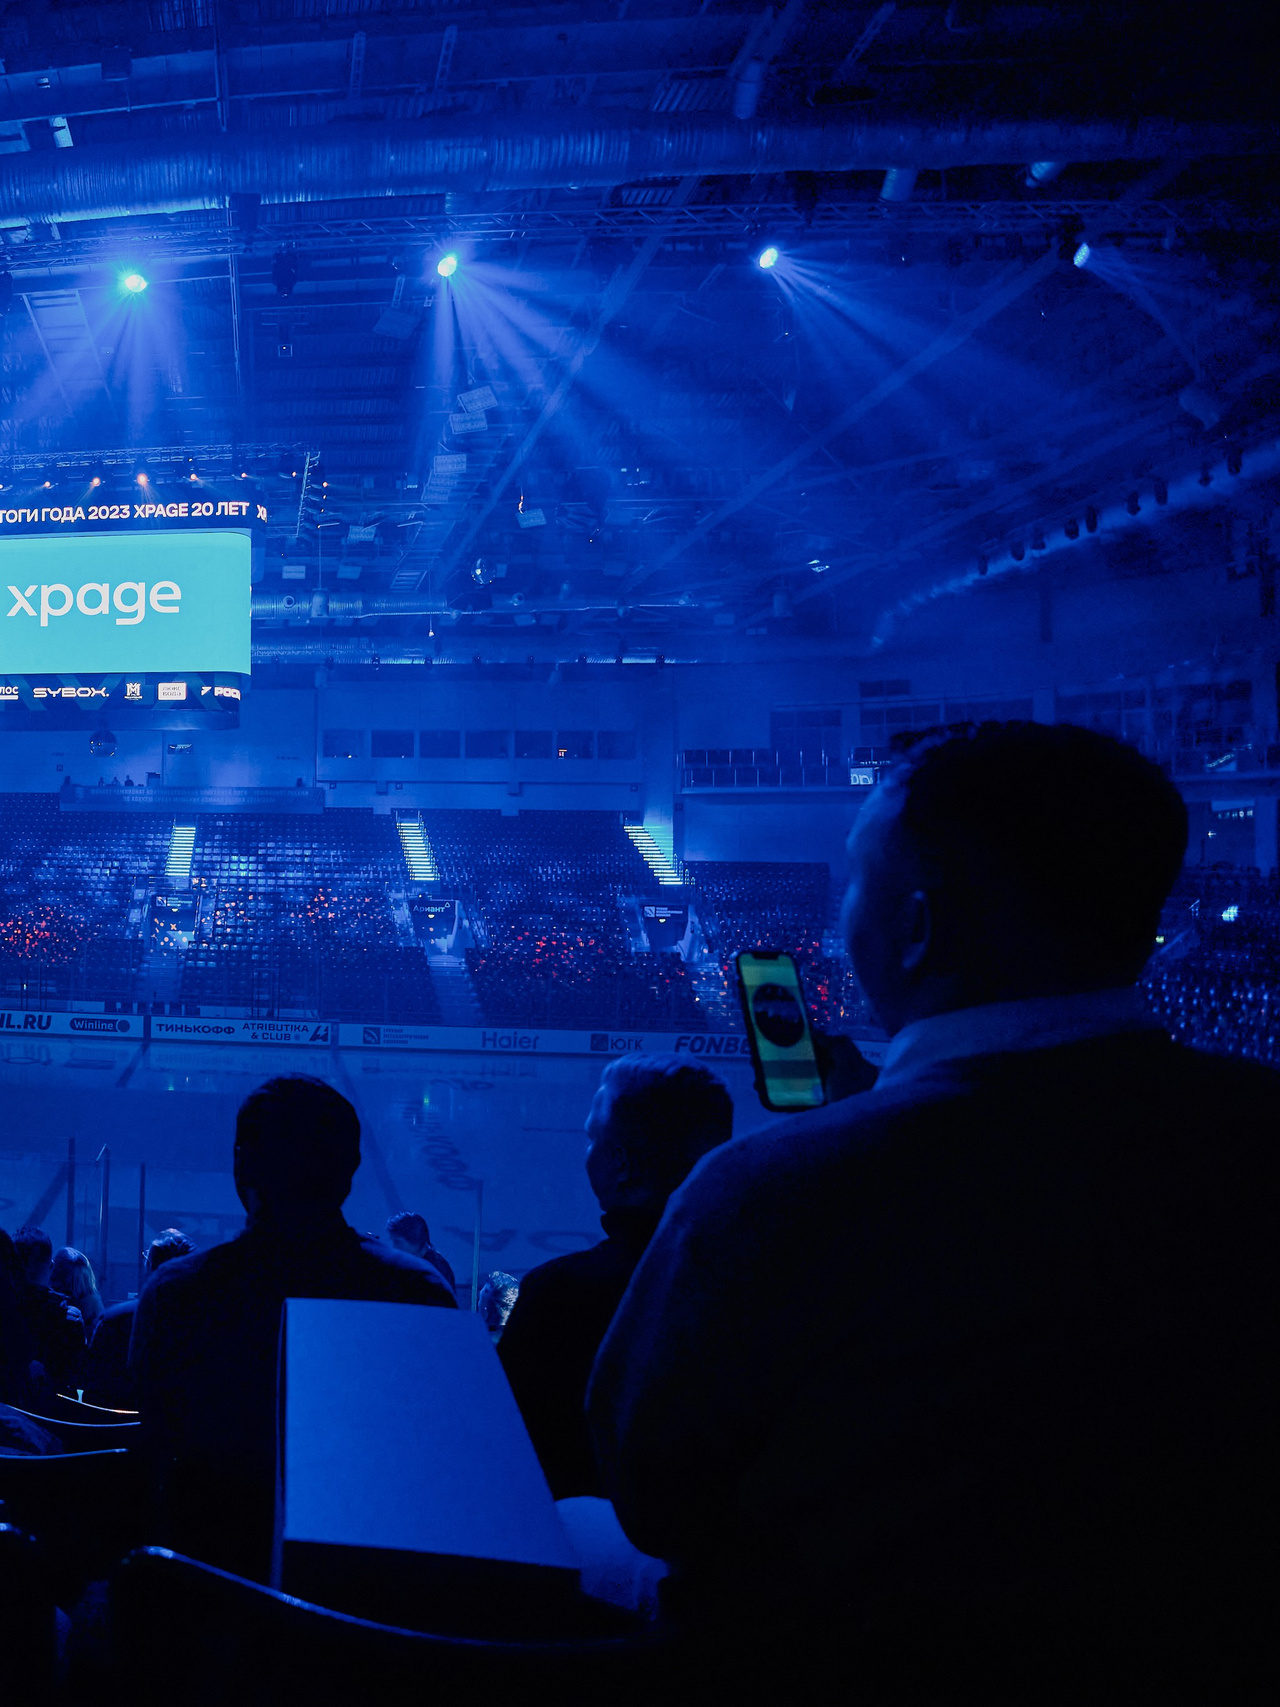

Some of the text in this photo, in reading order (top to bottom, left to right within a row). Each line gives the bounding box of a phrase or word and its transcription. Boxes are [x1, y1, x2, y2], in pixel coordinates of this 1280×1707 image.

[41, 506, 86, 523] ГОДА
[87, 505, 131, 520] 2023
[133, 502, 189, 518] XPAGE
[191, 502, 214, 517] 20
[215, 501, 250, 516] ЛЕТ
[6, 580, 182, 627] xpage
[73, 1019, 114, 1031] Winline
[155, 1023, 236, 1035] ТИНЬКОФФ
[242, 1022, 310, 1033] ATRIBUTIKA
[251, 1032, 291, 1041] & CLUB
[481, 1030, 540, 1049] Haier
[610, 1038, 644, 1050] ЮГК
[674, 1035, 751, 1054] FONBE
